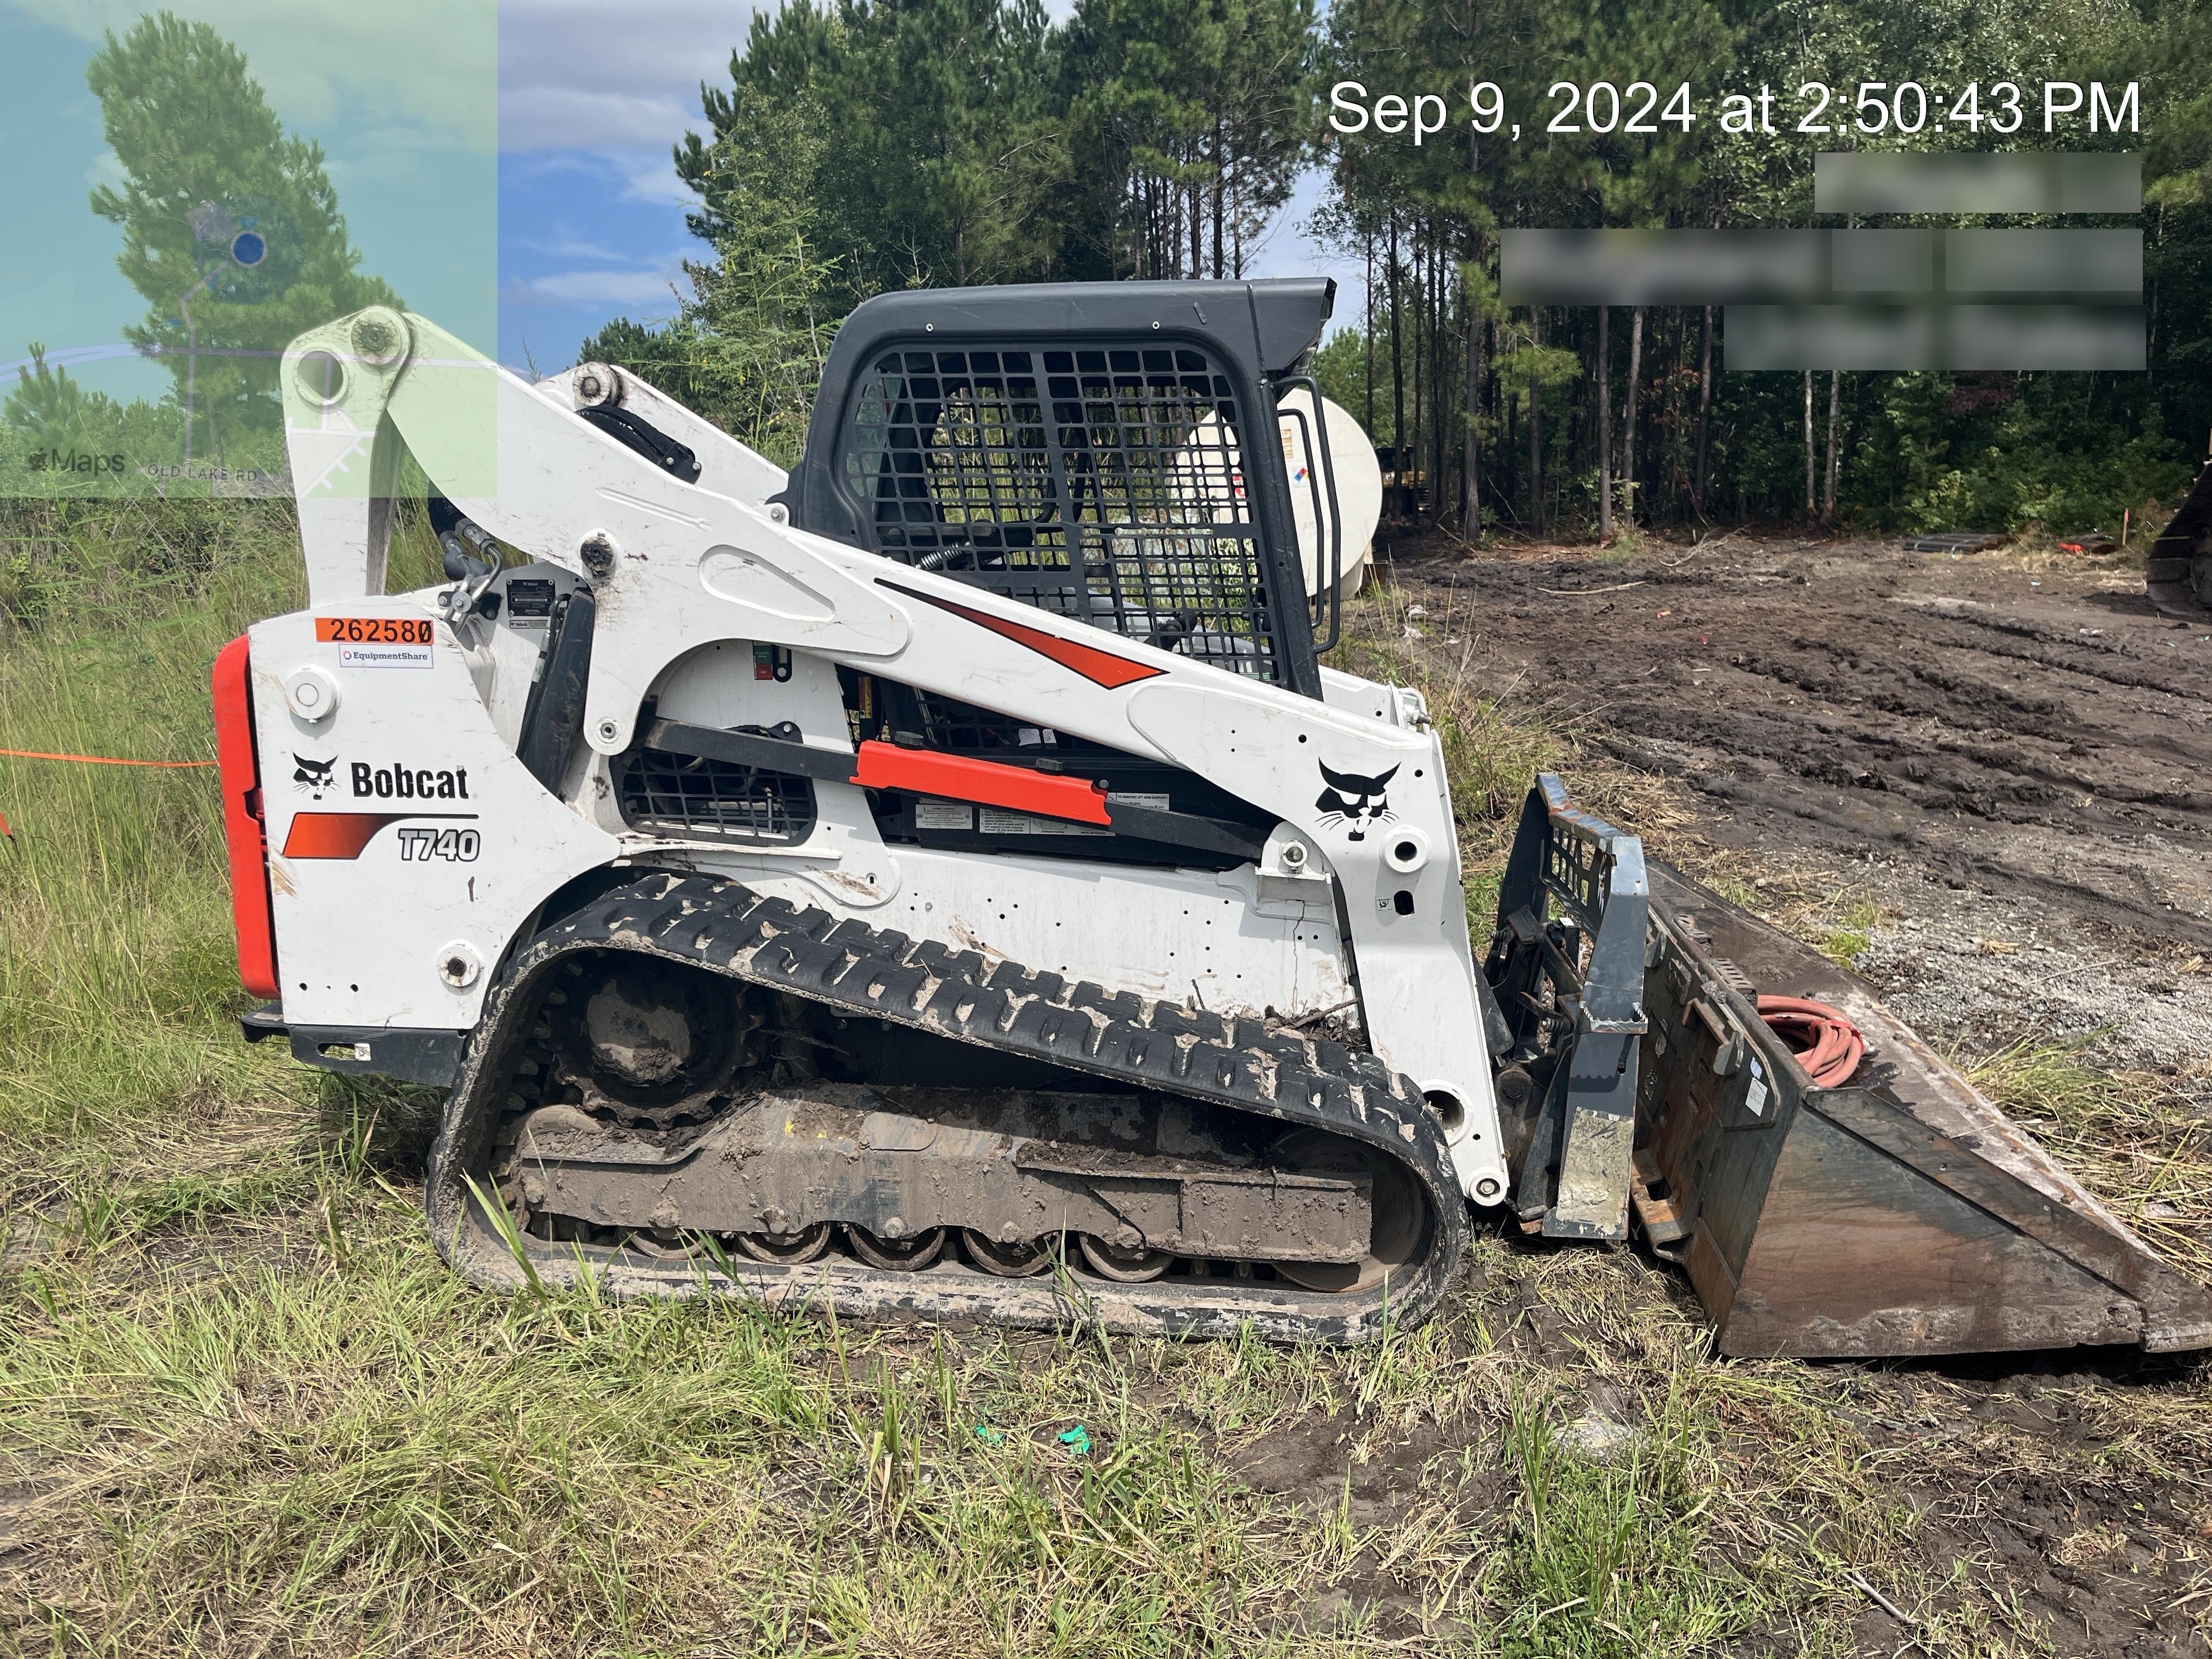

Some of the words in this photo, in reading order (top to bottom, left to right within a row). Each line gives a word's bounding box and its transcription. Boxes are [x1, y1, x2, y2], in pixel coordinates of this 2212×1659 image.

[353, 652, 428, 661] EquipmentShare
[351, 762, 470, 799] Bobcat
[398, 828, 481, 862] T740
